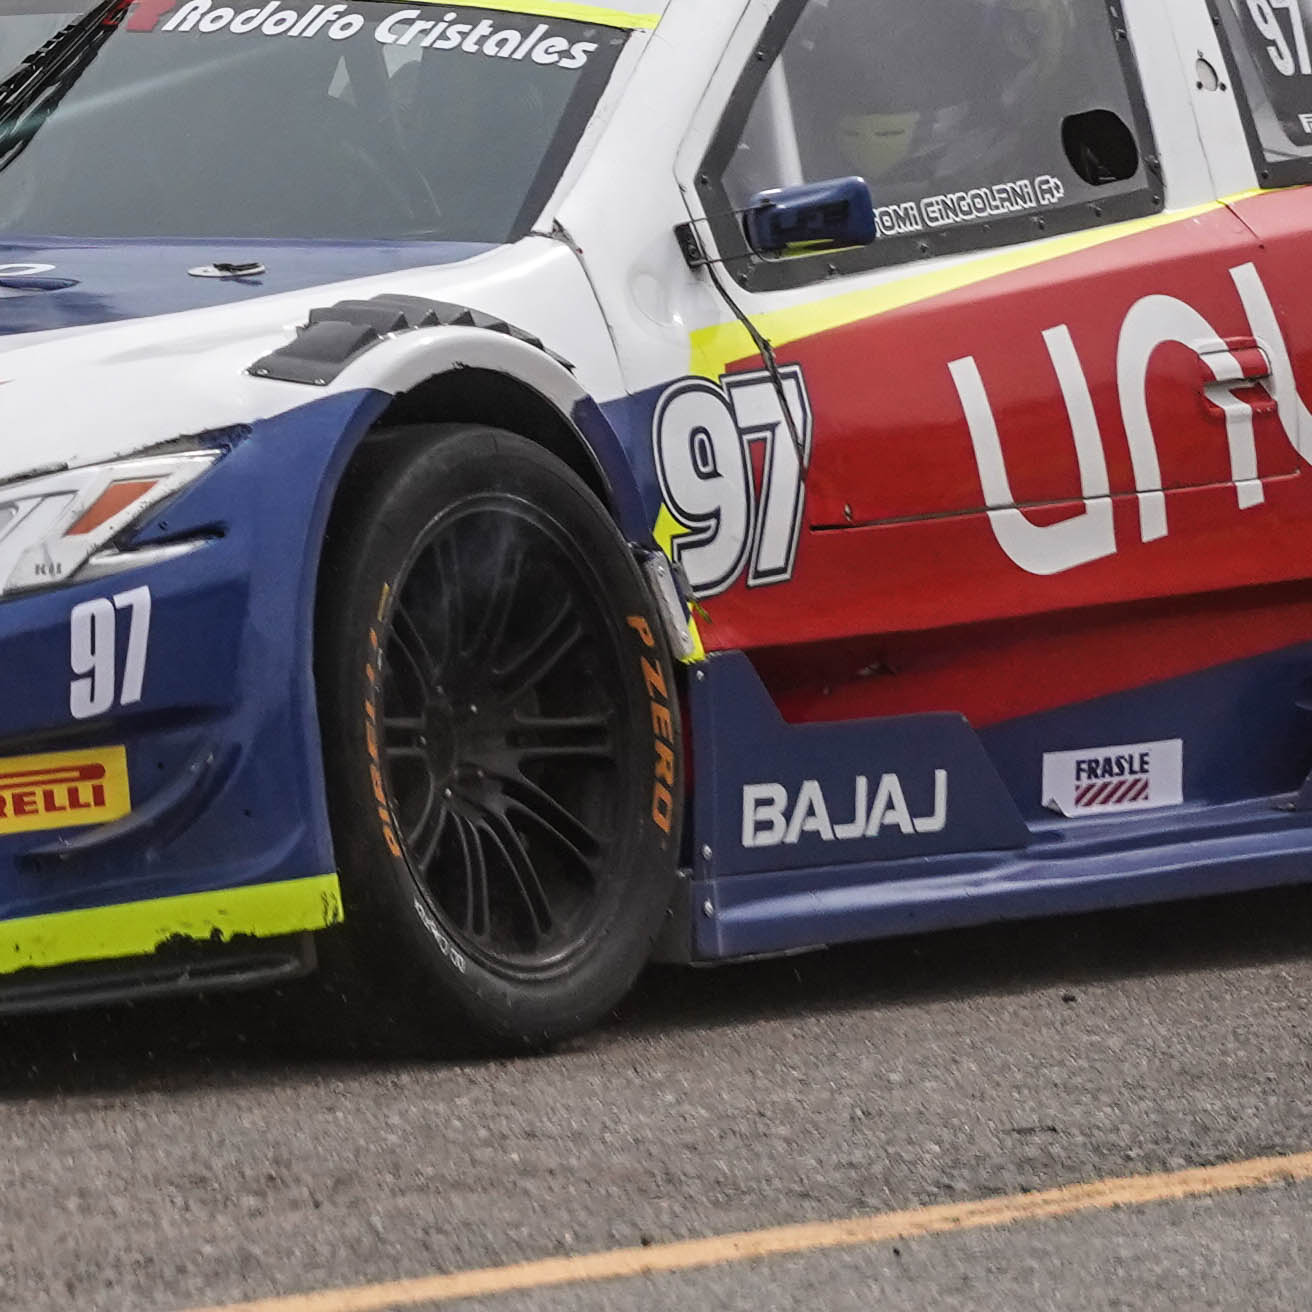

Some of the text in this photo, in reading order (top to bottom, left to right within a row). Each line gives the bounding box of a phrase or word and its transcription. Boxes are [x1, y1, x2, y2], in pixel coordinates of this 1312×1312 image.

[374, 9, 599, 70] Cristales
[652, 362, 814, 600] 97
[69, 585, 153, 719] 97
[639, 658, 673, 835] ZERO
[741, 768, 948, 849] BAJAJ
